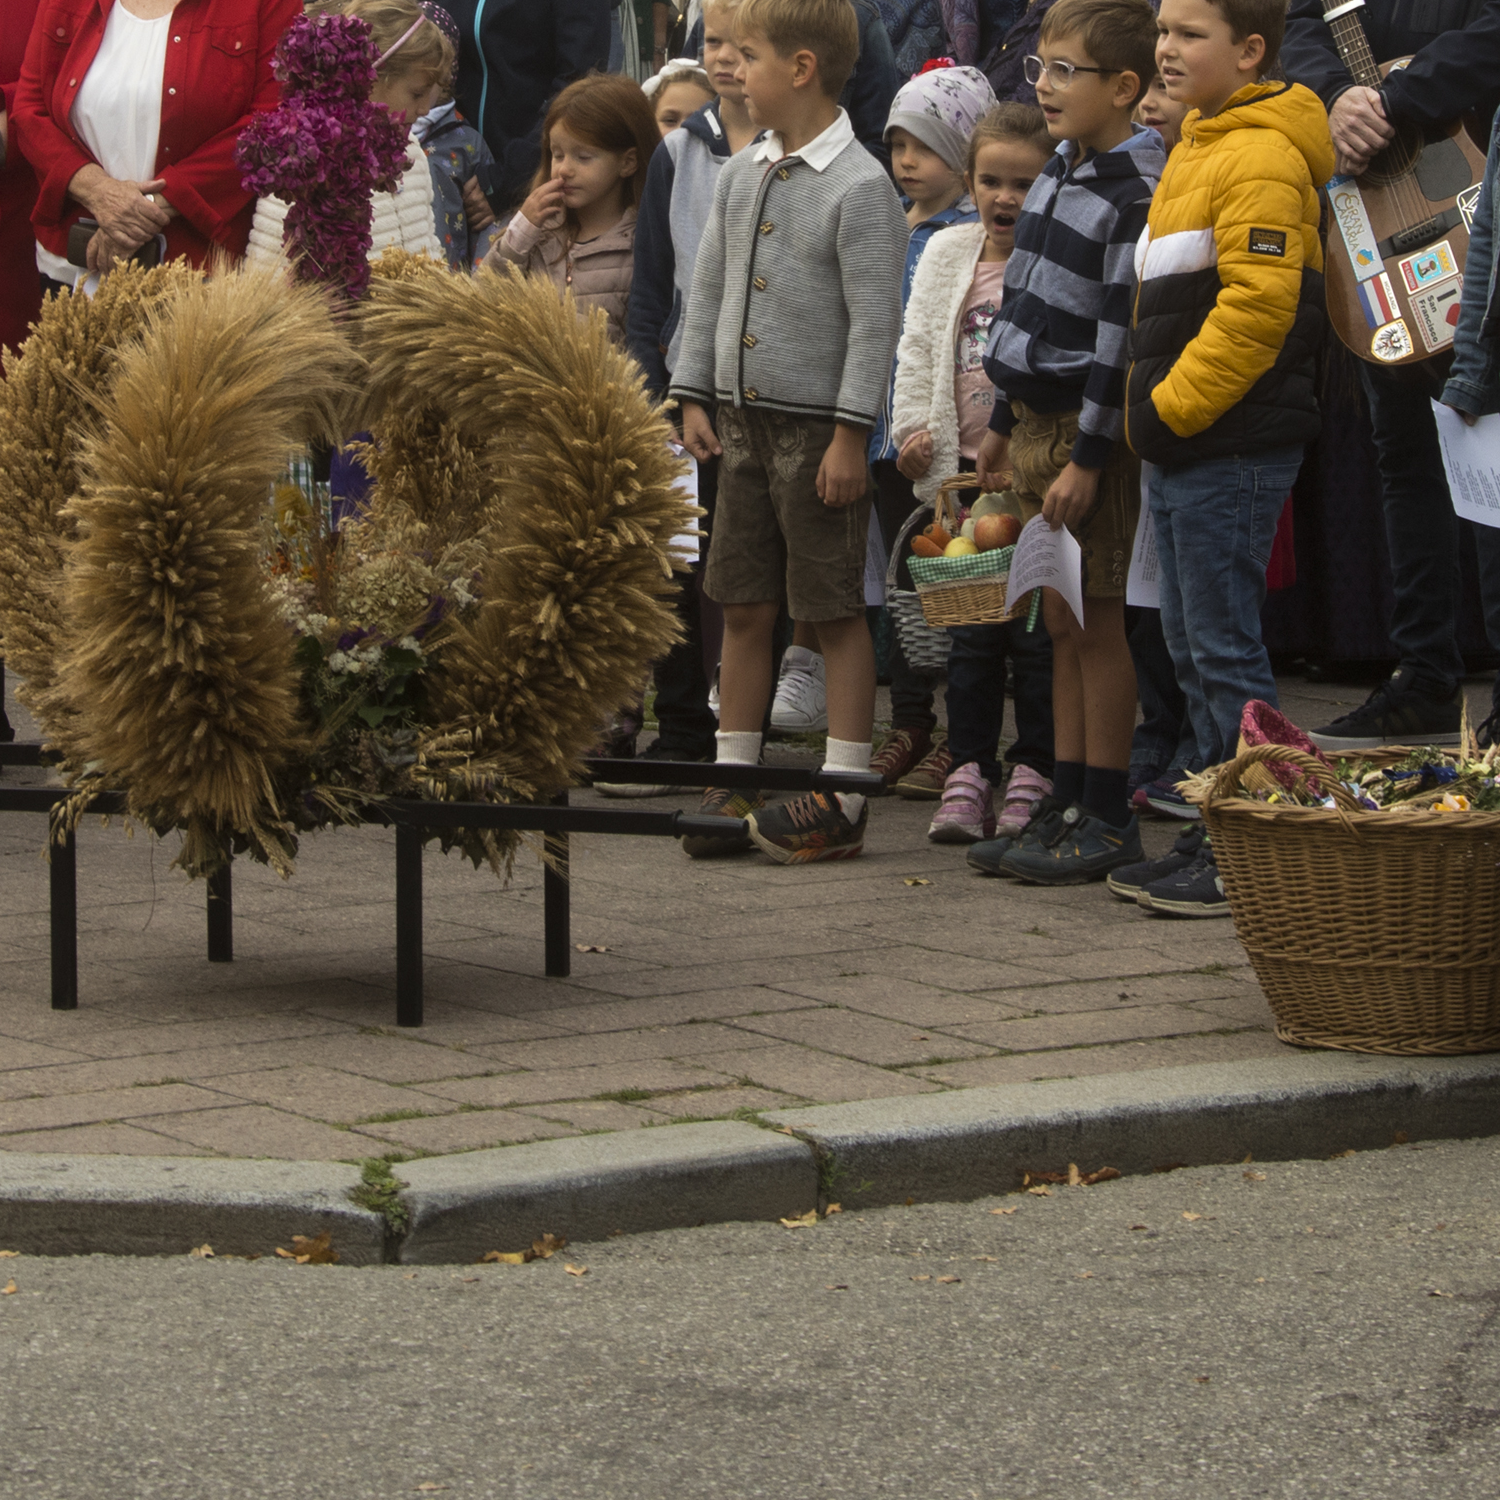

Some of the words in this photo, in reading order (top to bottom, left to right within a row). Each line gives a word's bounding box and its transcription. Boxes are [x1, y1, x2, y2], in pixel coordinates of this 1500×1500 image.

[1334, 192, 1360, 252] CANARIA
[1345, 194, 1365, 234] GRAN
[1384, 280, 1397, 310] HOLLAND
[1427, 294, 1438, 313] San
[1418, 299, 1439, 343] Francisco
